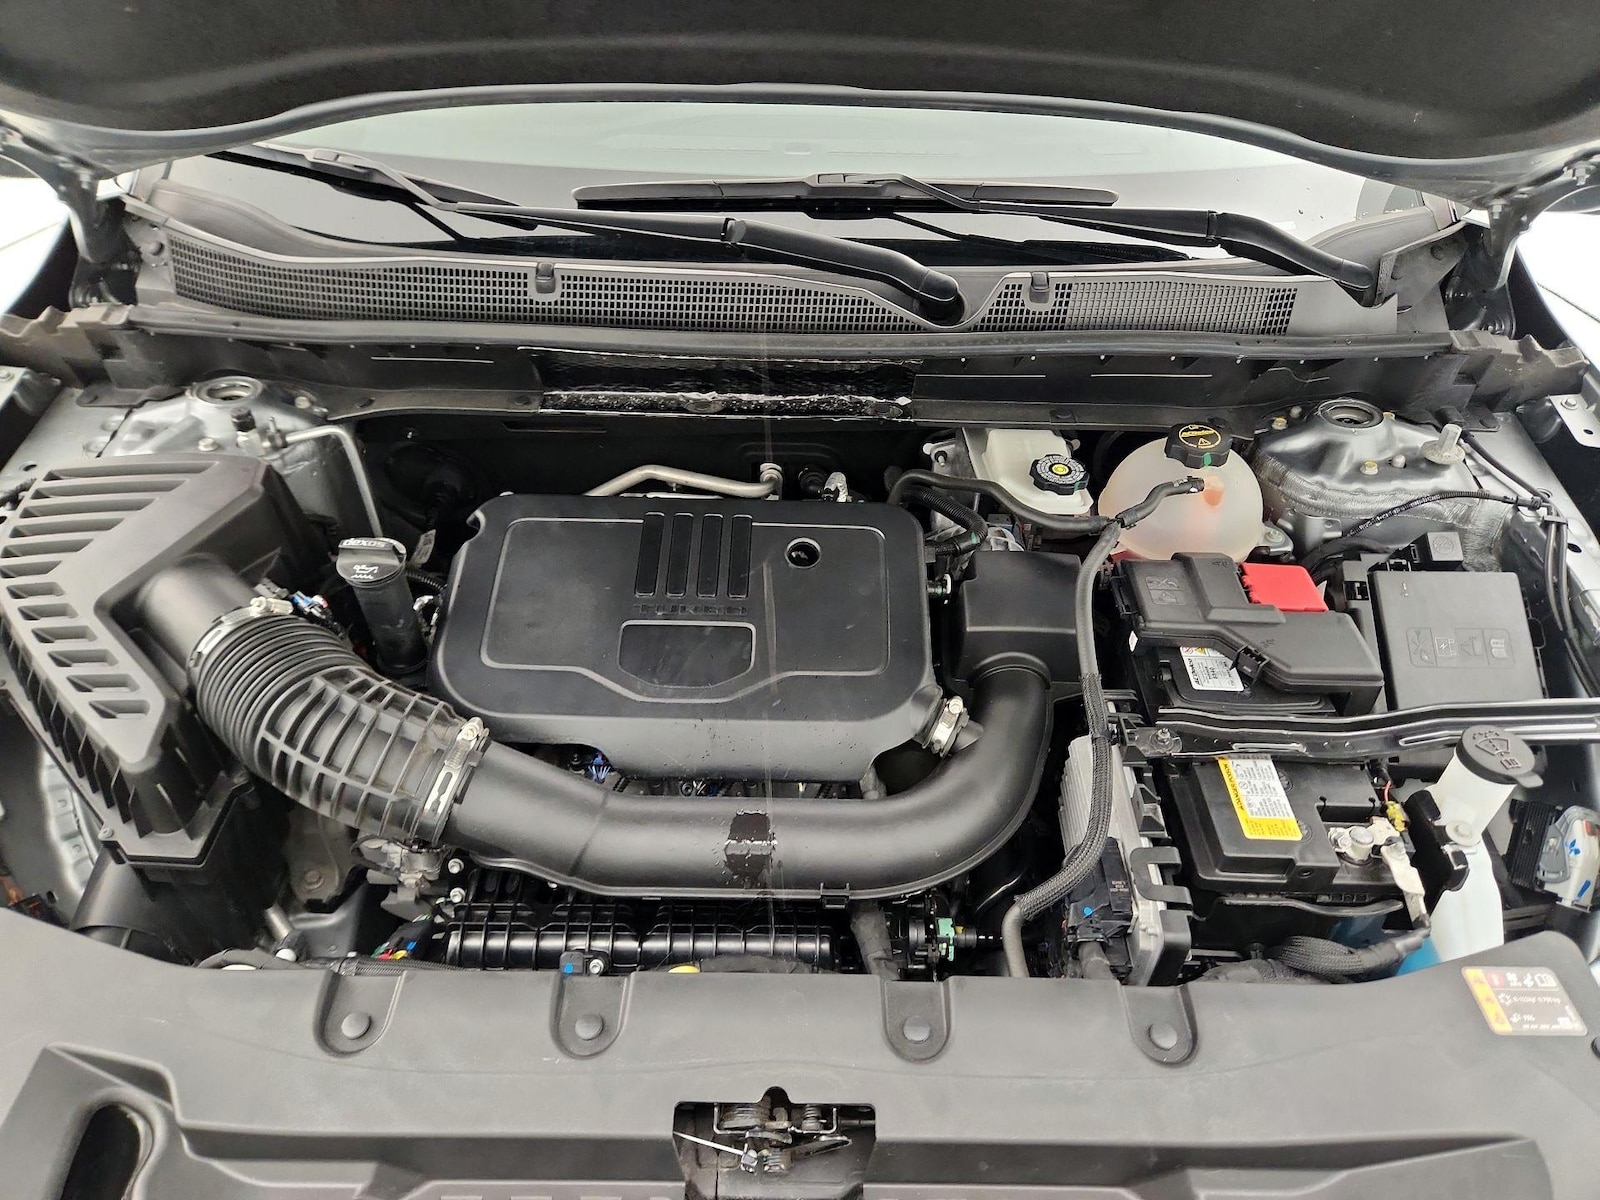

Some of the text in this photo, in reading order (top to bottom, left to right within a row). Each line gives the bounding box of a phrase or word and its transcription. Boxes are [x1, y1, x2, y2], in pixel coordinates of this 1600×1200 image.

[342, 537, 386, 548] dexos
[633, 603, 748, 617] TURBO
[1187, 658, 1200, 686] ACDelco
